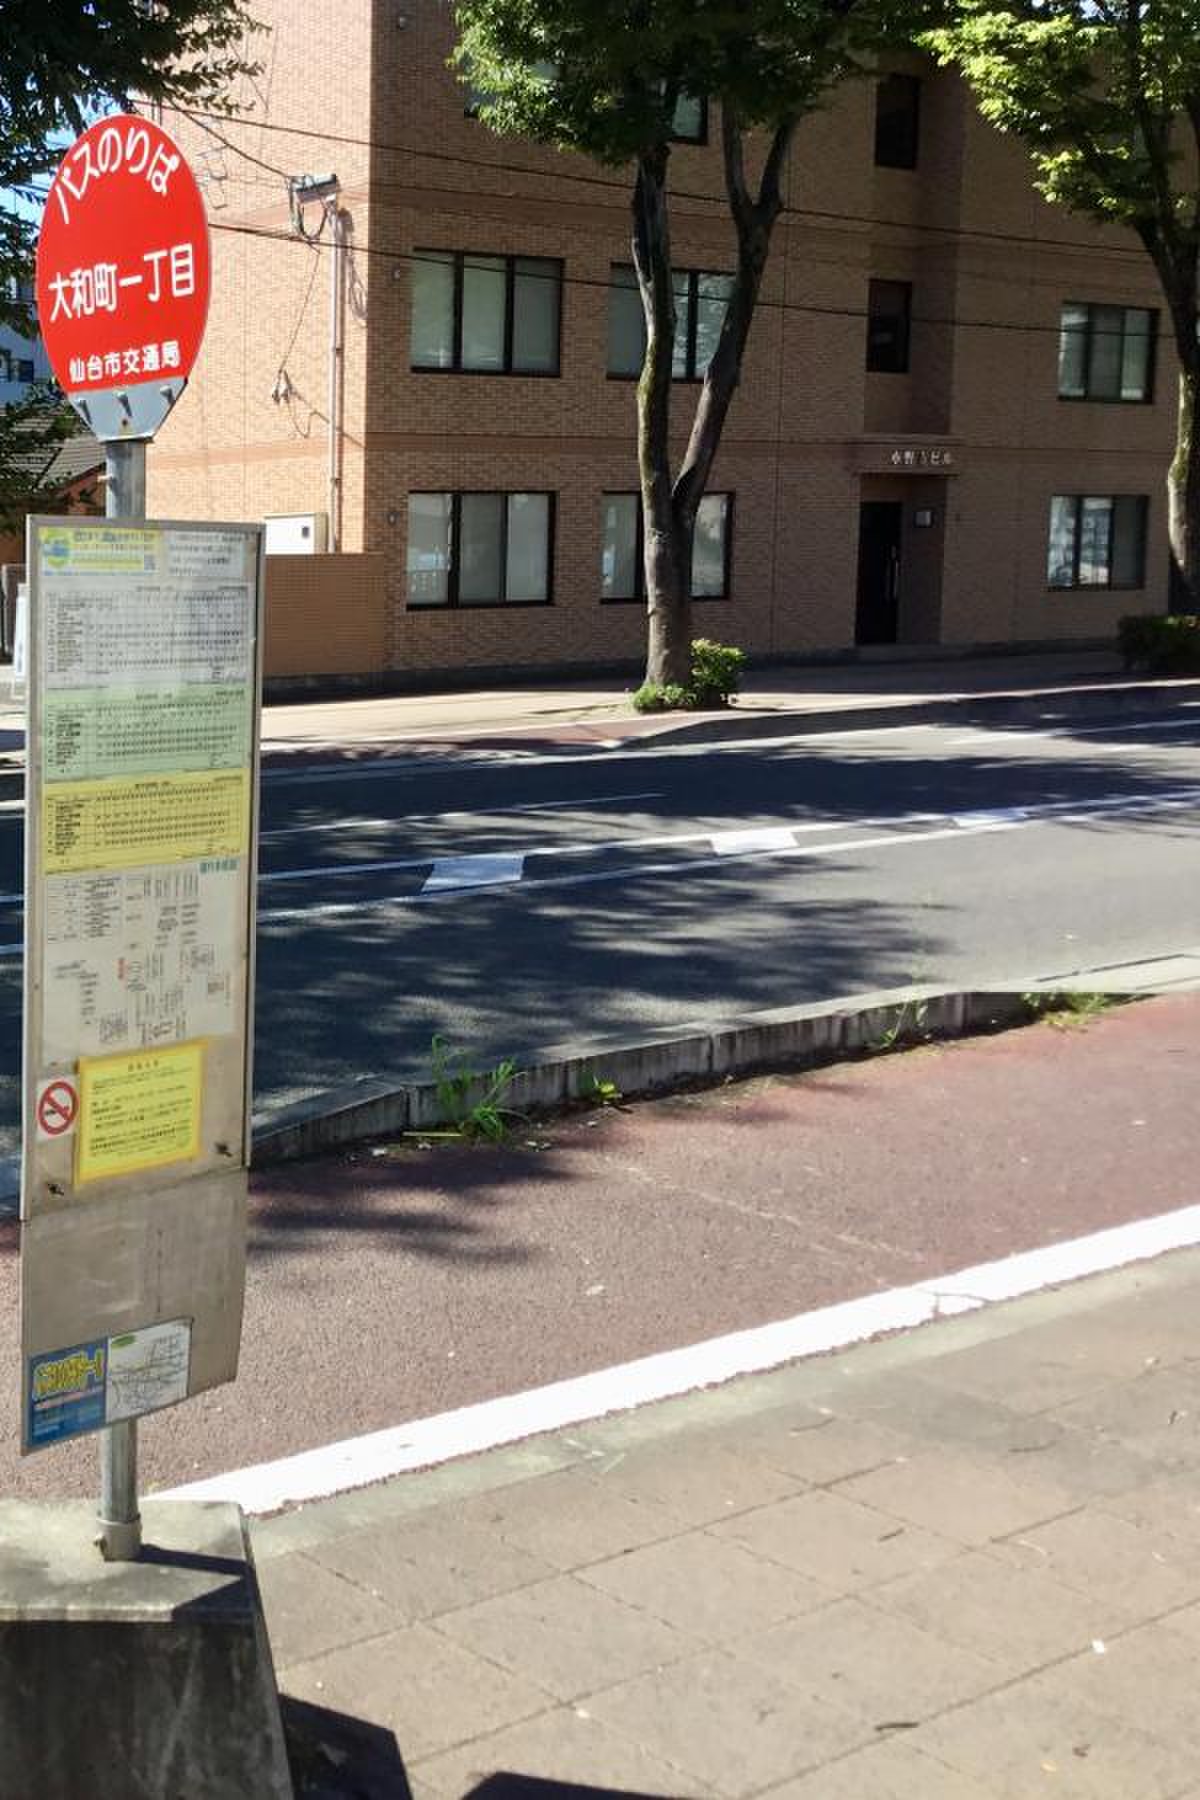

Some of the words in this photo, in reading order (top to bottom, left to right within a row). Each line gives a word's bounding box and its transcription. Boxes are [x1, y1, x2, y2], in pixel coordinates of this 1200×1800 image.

[54, 127, 180, 224] バスのりば
[47, 243, 196, 321] 大和町一丁目
[68, 340, 181, 383] 仙台市交通局
